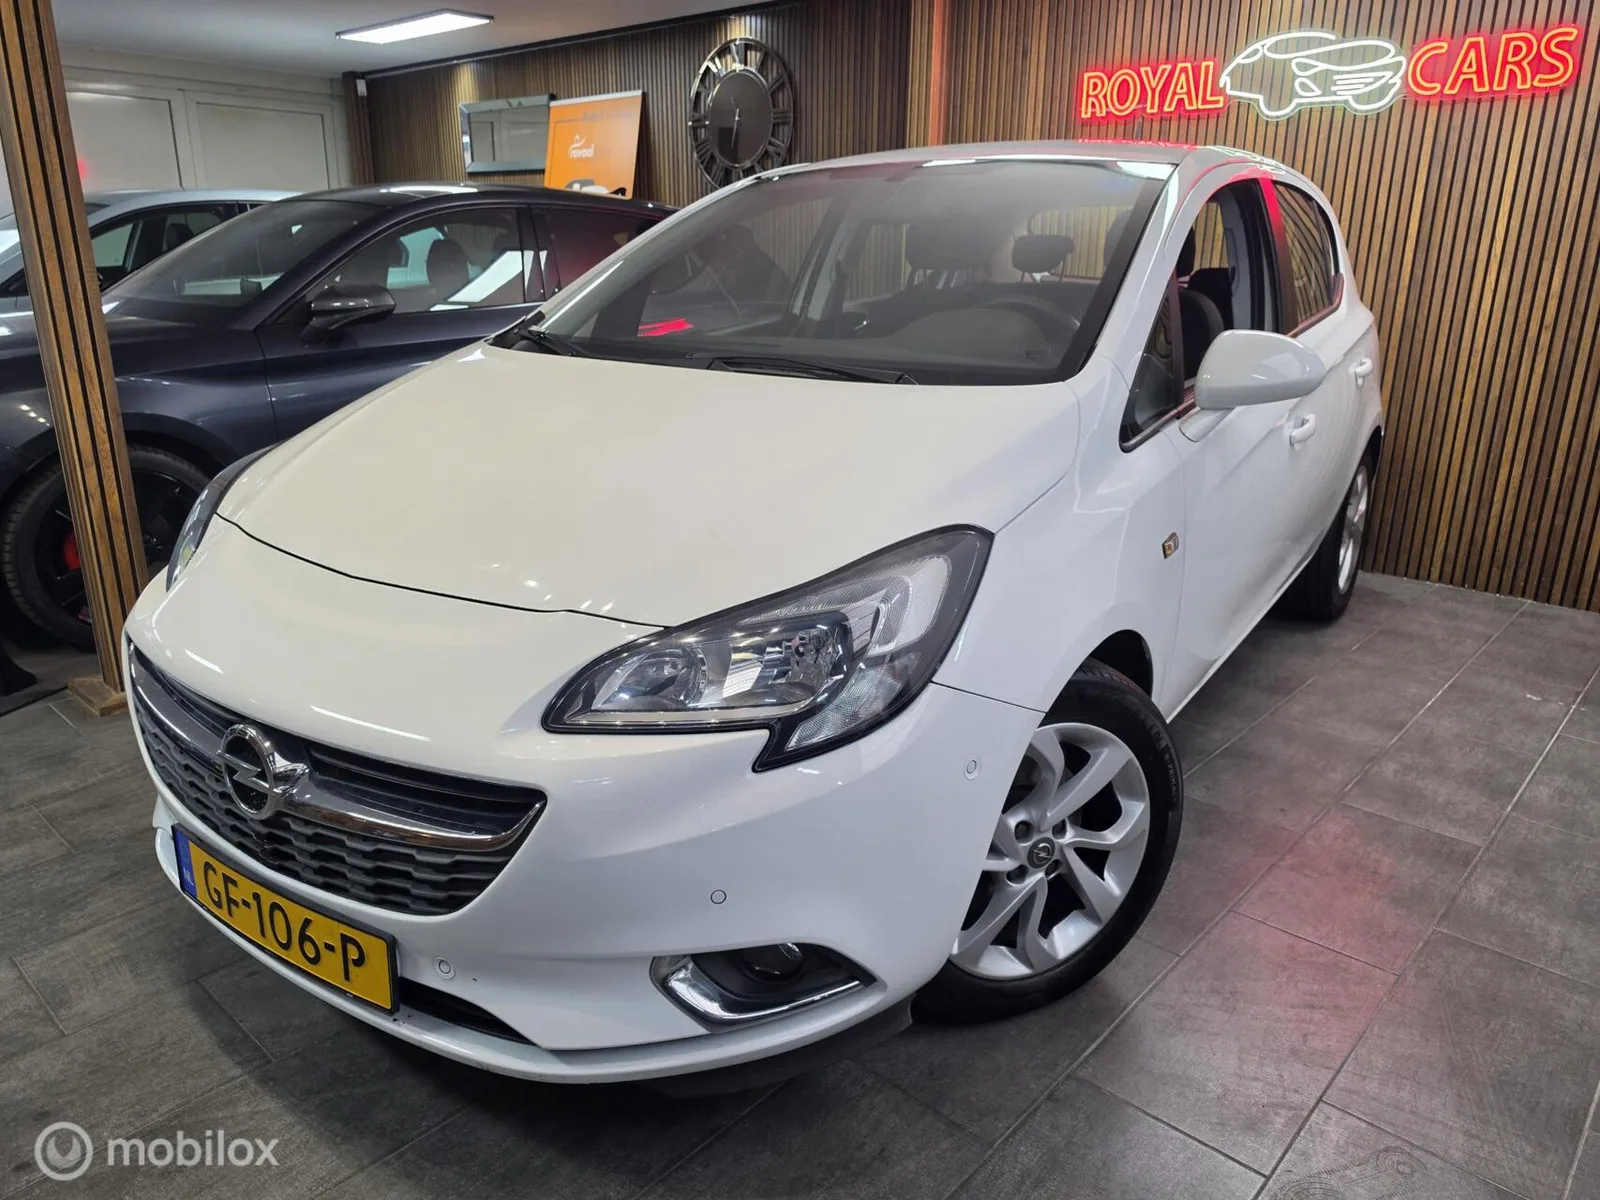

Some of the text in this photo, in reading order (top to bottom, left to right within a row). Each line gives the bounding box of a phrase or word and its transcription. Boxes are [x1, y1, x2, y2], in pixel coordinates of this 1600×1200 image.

[1081, 27, 1579, 118] ROYAL CARS
[203, 861, 366, 982] GF-106-P
